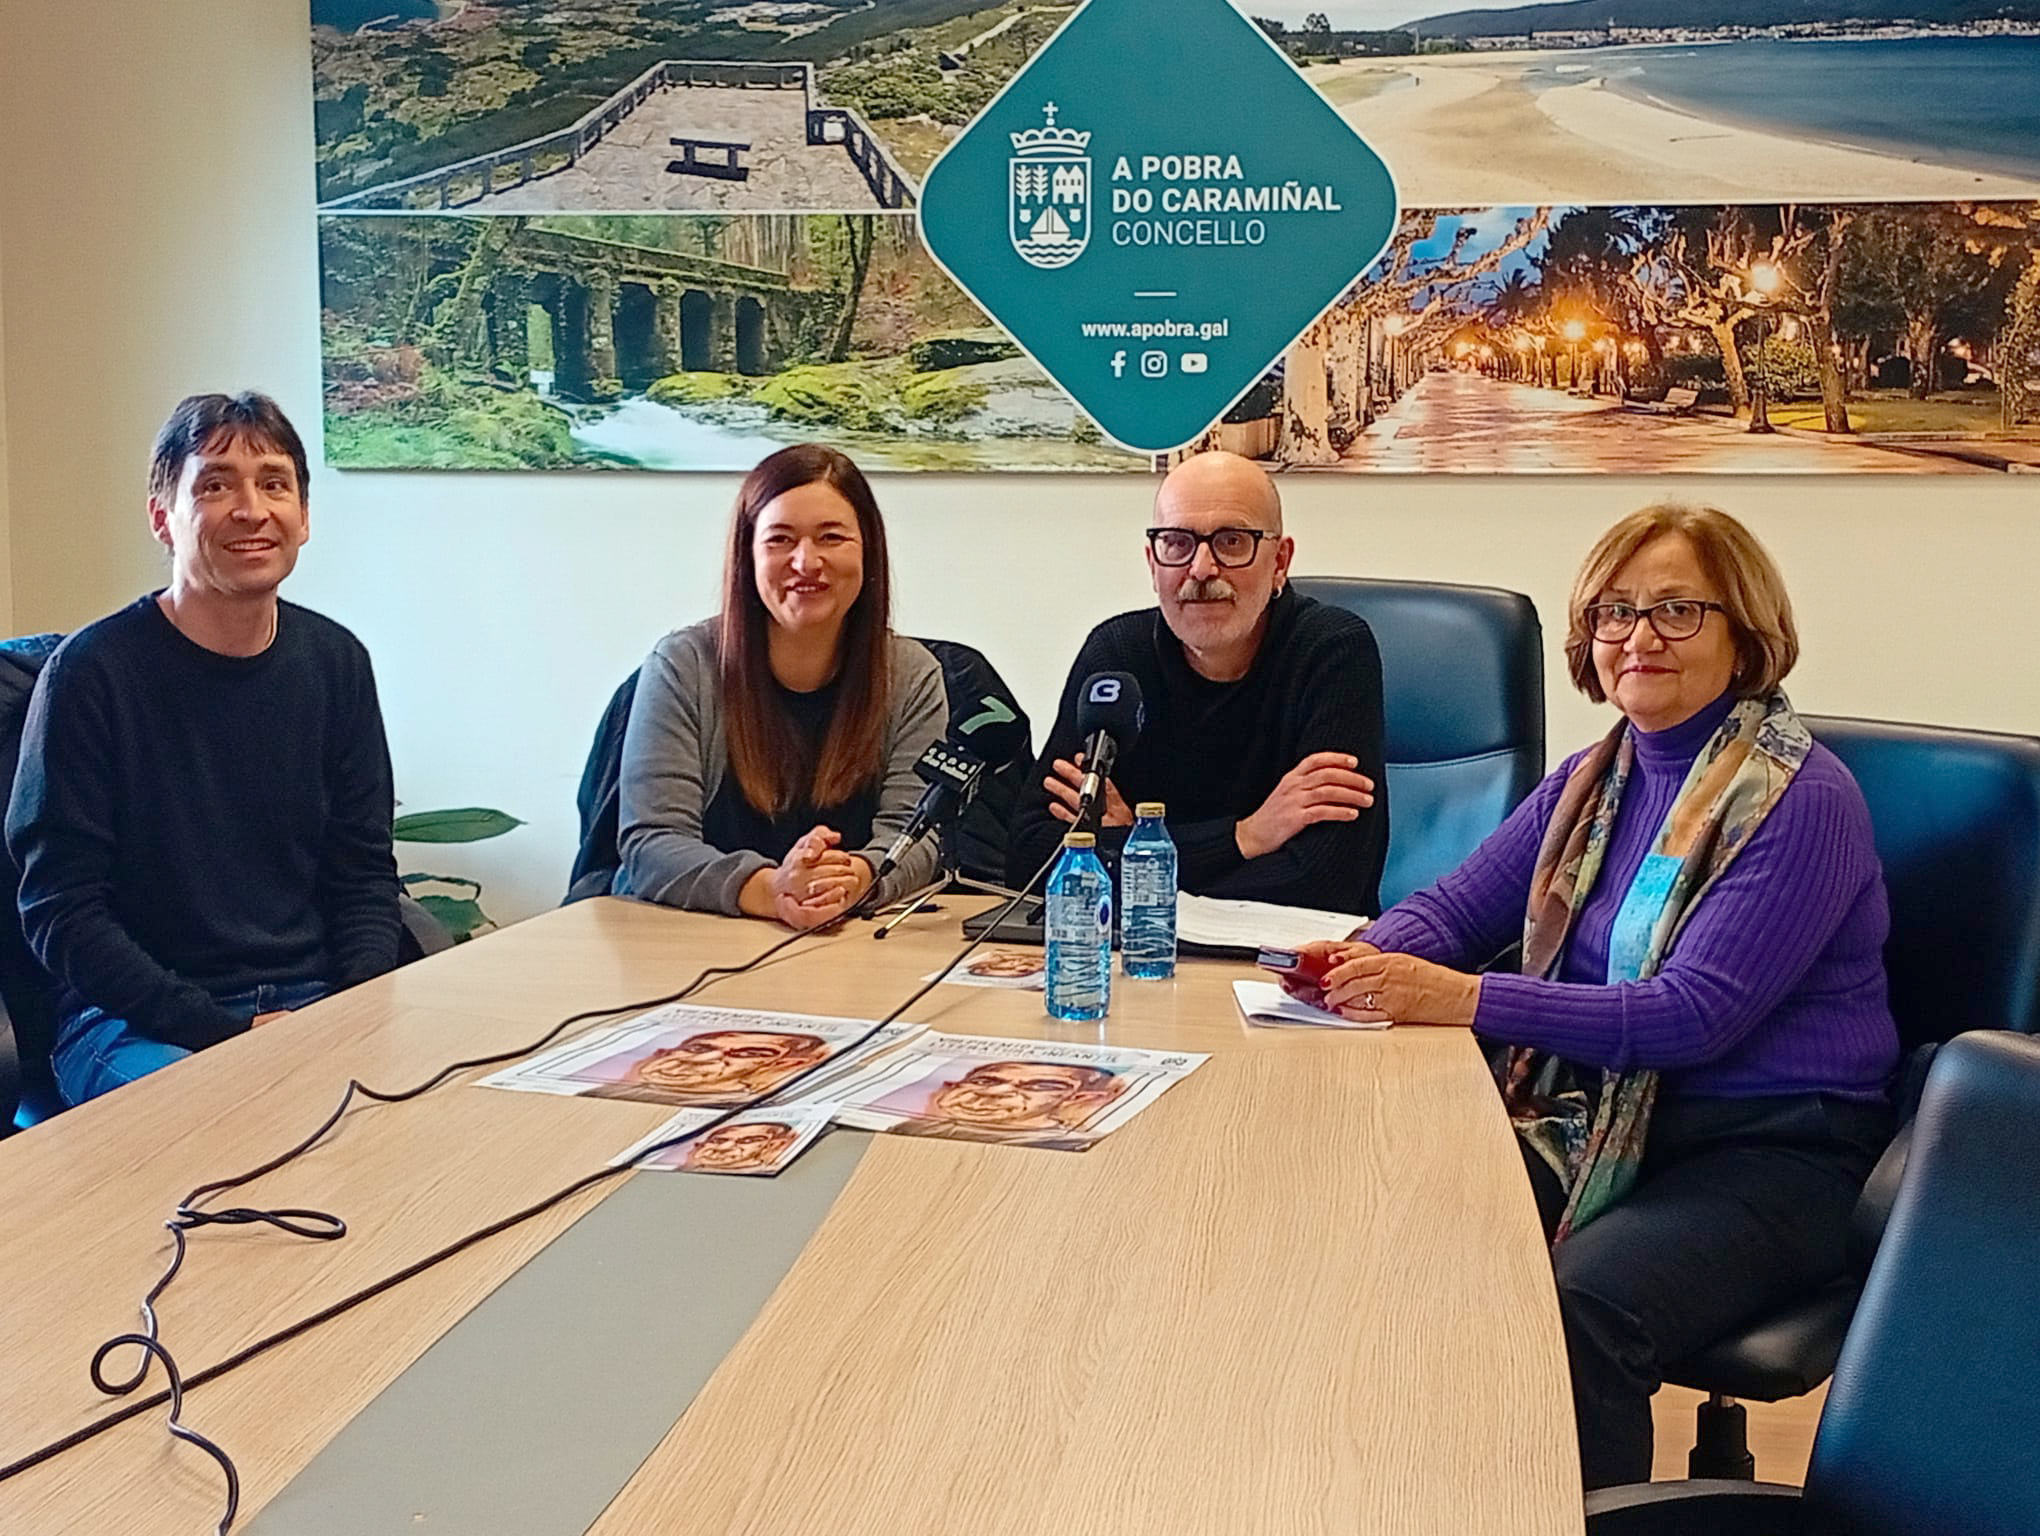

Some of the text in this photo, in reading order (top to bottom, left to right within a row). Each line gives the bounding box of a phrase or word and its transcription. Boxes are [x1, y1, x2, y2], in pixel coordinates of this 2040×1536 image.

[1112, 155, 1243, 181] A POBRA
[1112, 181, 1341, 213] DO CARAMIÑAL
[1111, 219, 1266, 246] CONCELLO
[1081, 319, 1229, 341] www.apobra.gal
